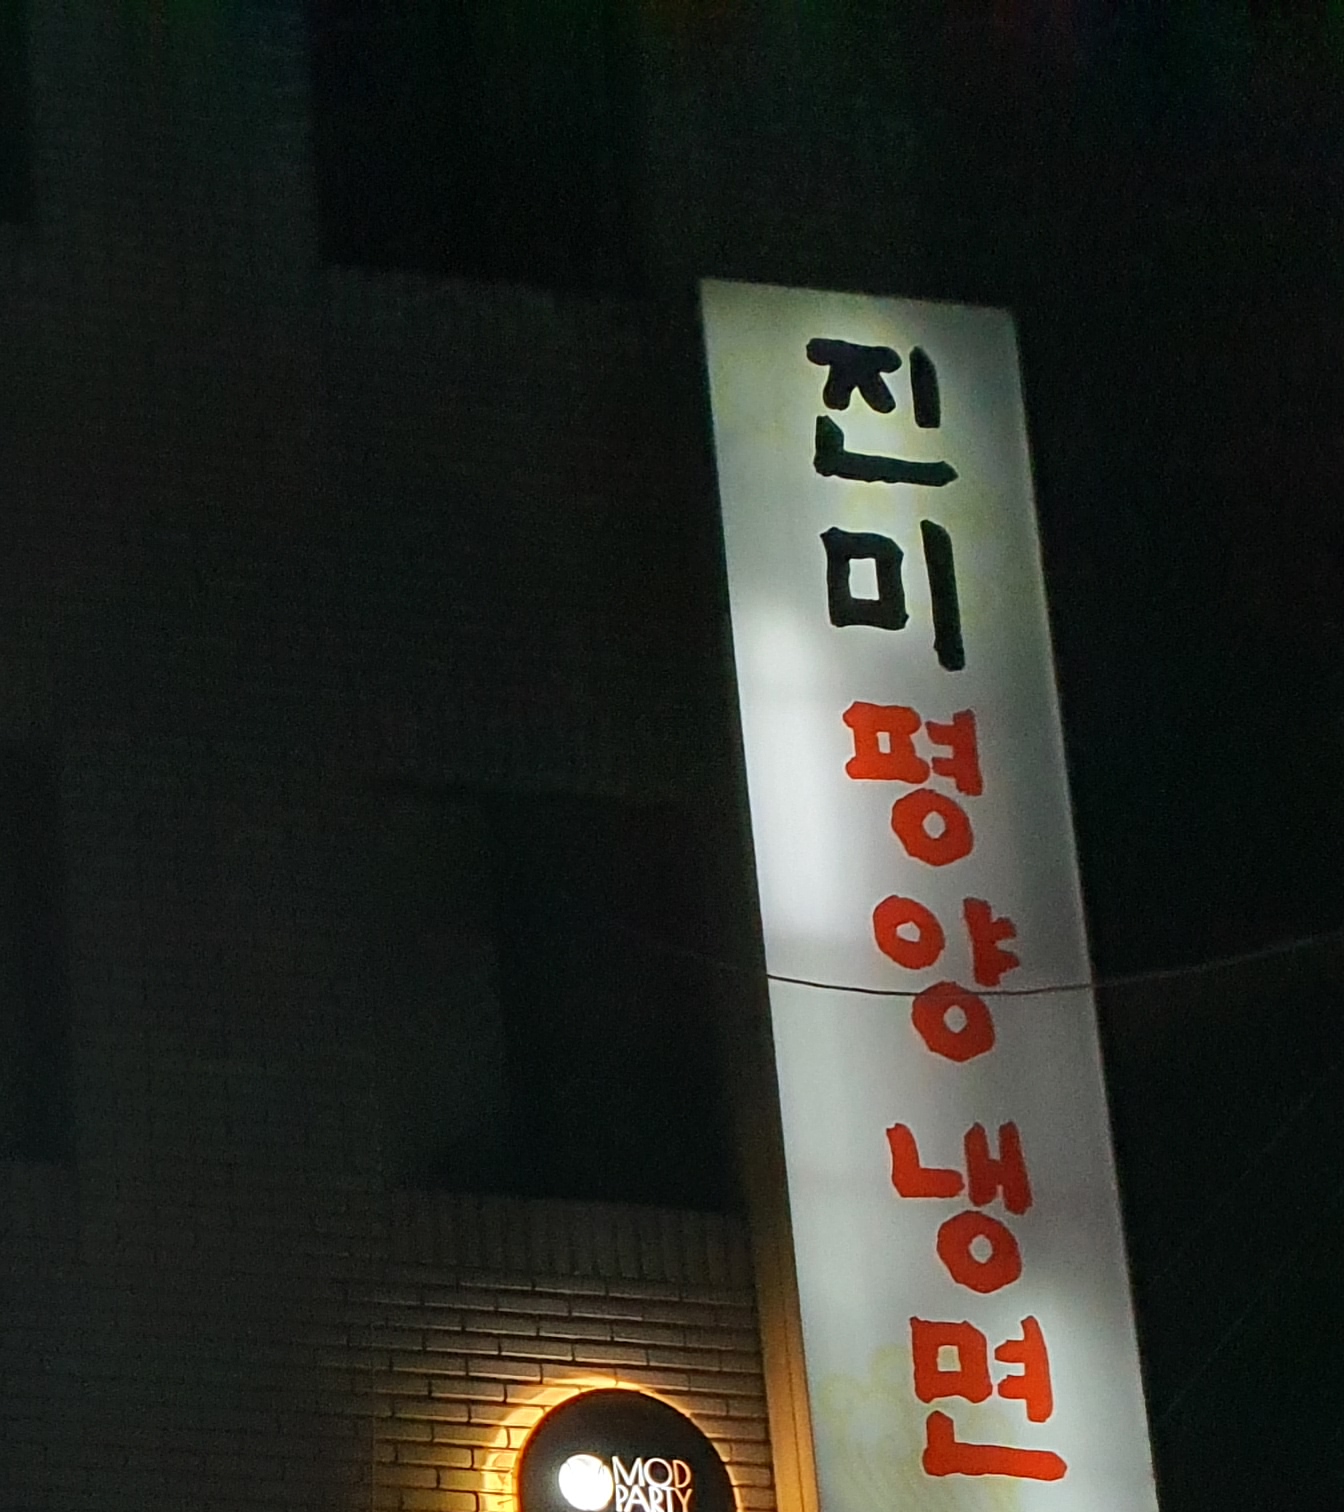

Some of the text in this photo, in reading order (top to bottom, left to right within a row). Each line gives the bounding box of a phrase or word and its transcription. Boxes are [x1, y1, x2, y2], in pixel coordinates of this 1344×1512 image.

[806, 337, 1068, 1482] 진미 평양냉면
[612, 1456, 692, 1488] MOD
